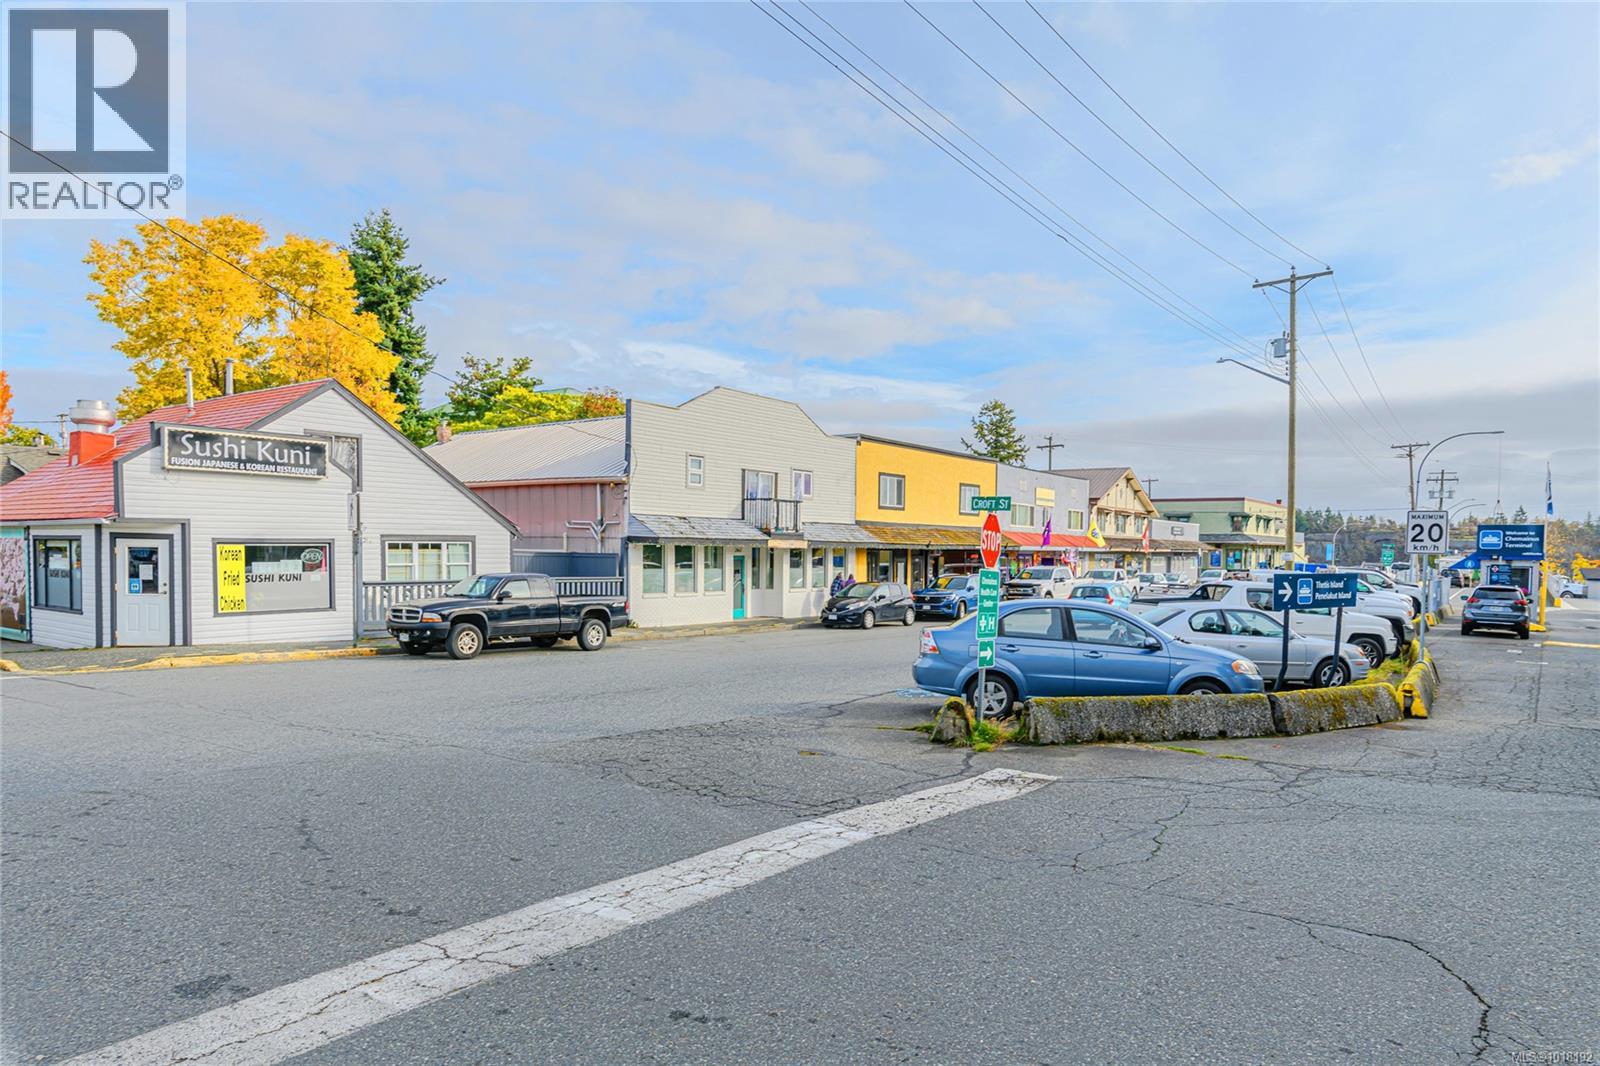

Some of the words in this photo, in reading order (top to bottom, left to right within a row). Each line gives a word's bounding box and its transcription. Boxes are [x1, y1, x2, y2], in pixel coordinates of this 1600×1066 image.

[180, 433, 246, 460] Sushi
[257, 441, 311, 466] Kuni
[171, 457, 201, 466] FUSION
[202, 459, 239, 470] JAPANESE
[246, 463, 276, 472] KOREAN
[277, 466, 318, 475] RESTAURANT
[973, 499, 996, 509] CROFT
[982, 529, 1001, 552] STOP
[1411, 523, 1444, 543] 20
[220, 546, 242, 561] Korean
[223, 570, 241, 586] Fried
[245, 574, 275, 583] SUSHI
[278, 573, 302, 582] KUNI
[220, 596, 245, 611] Chicken
